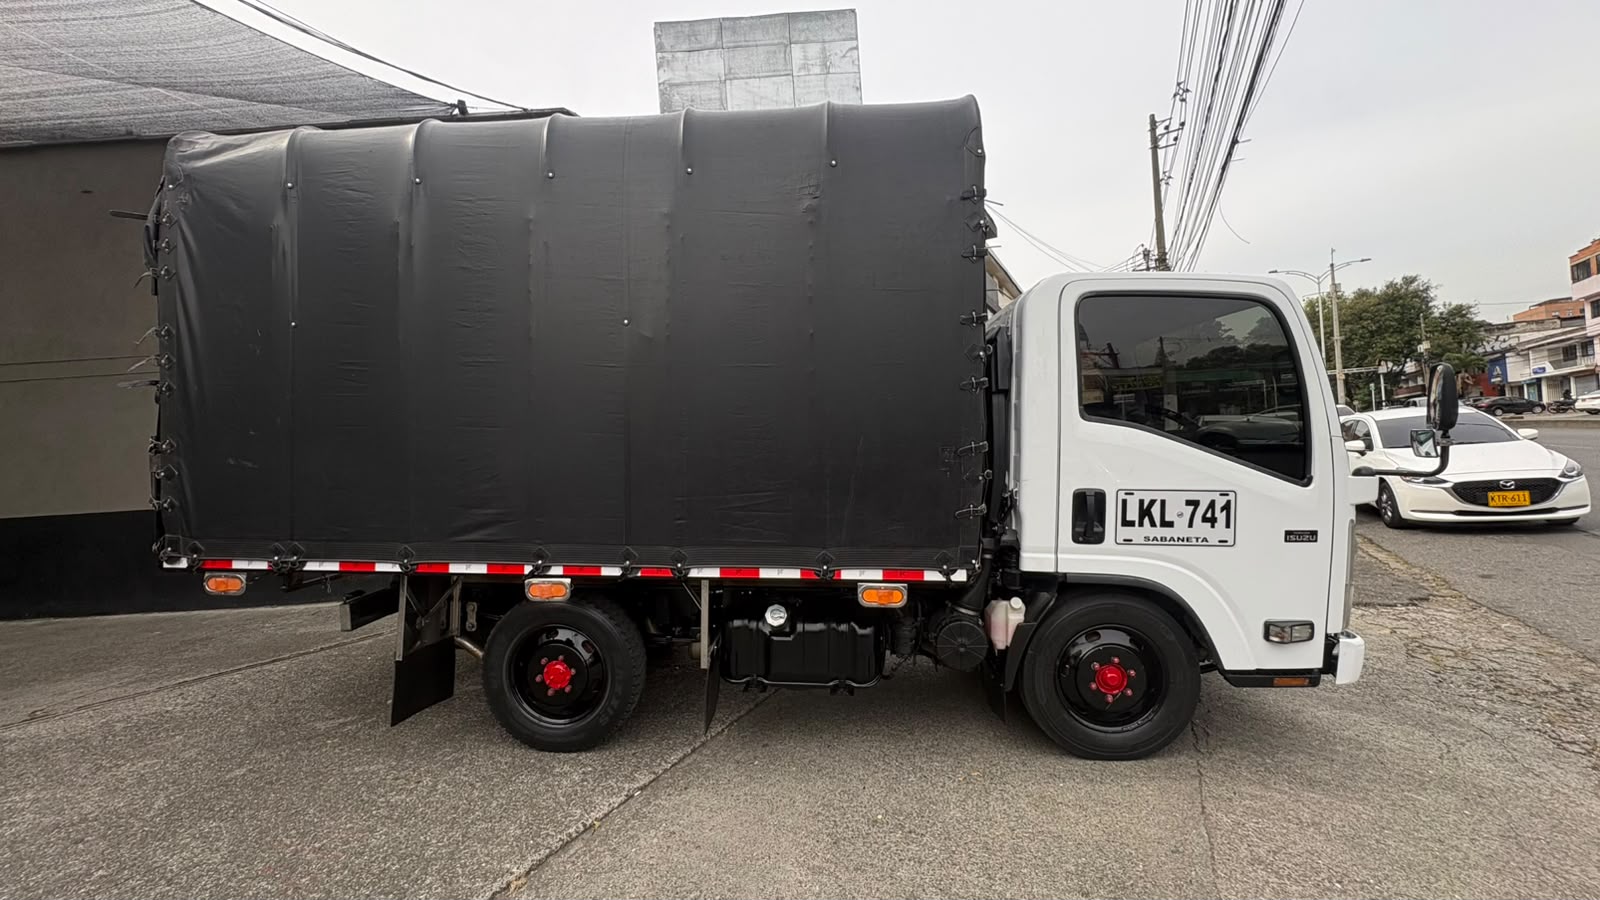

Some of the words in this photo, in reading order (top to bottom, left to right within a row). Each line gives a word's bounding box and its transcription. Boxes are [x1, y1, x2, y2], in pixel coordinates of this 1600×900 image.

[1120, 498, 1175, 528] LKL
[1184, 499, 1232, 529] 741
[1143, 535, 1209, 543] SABANETA
